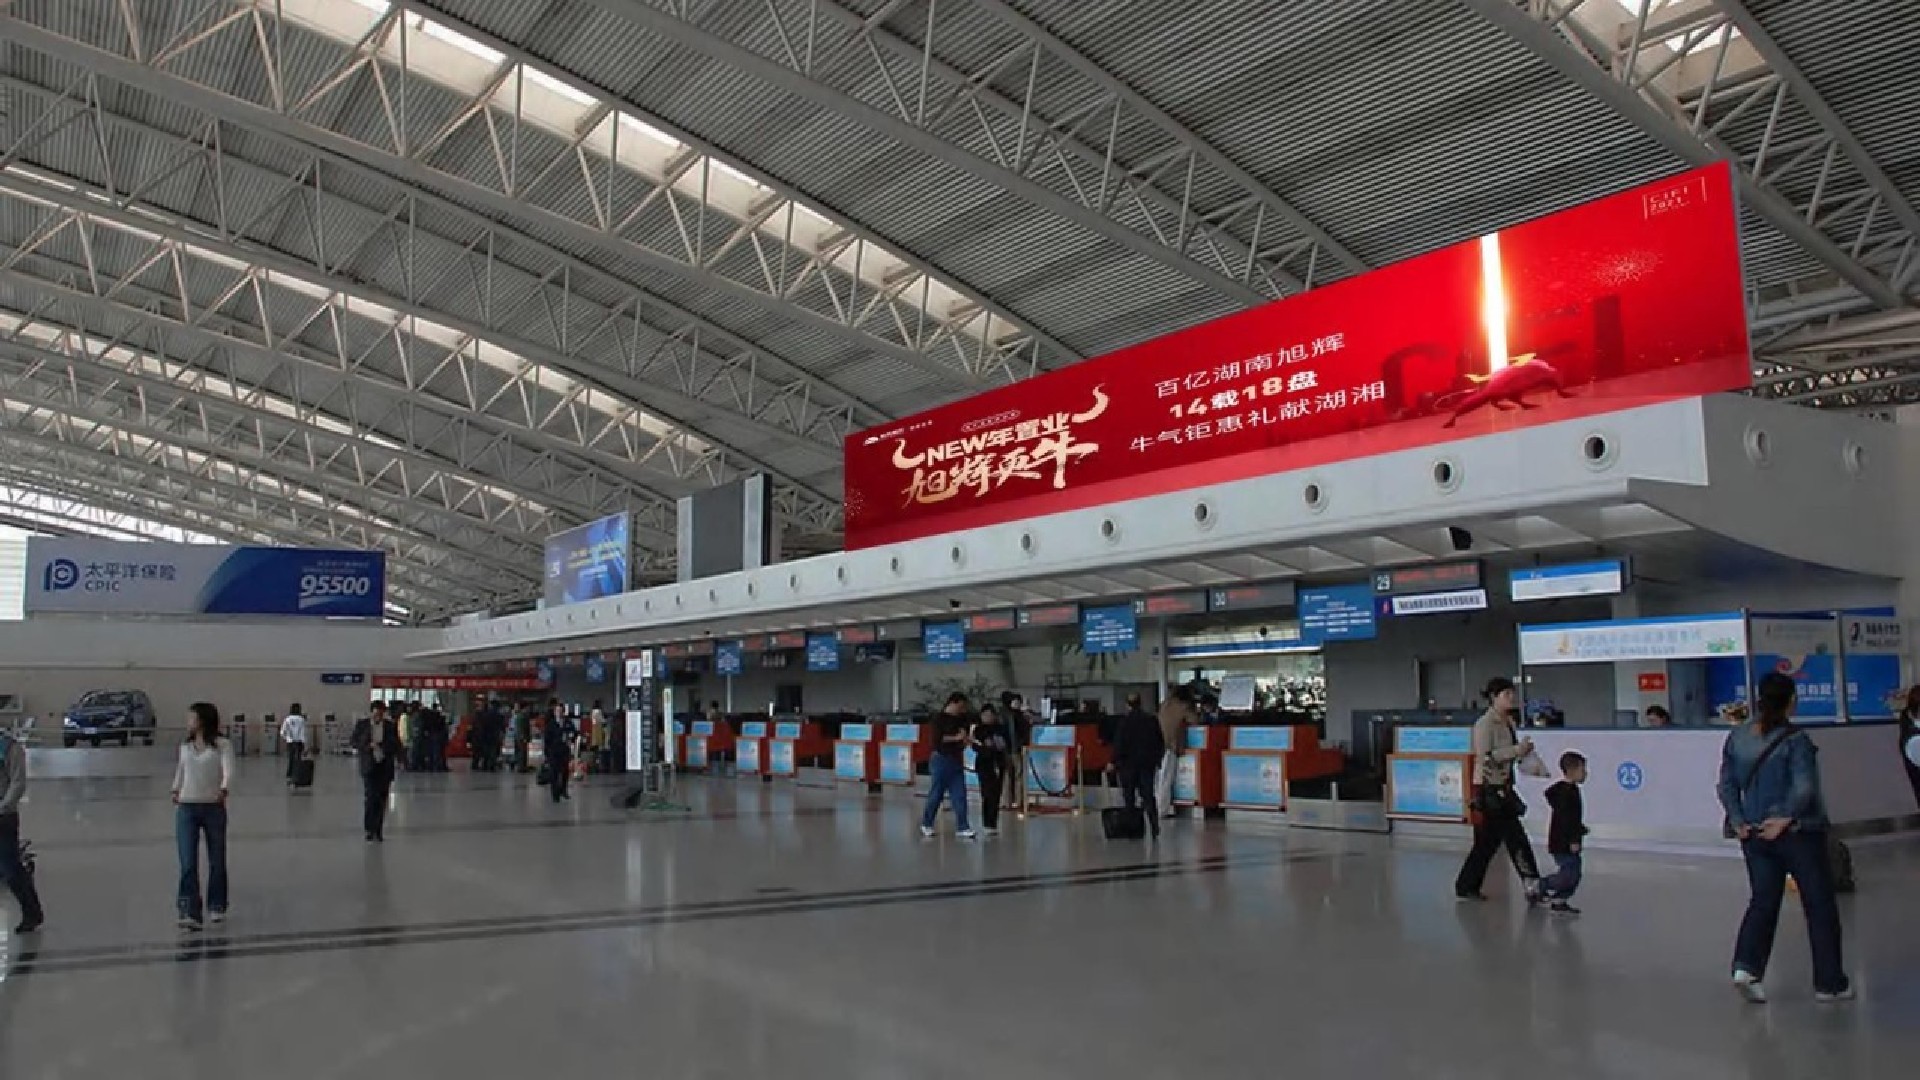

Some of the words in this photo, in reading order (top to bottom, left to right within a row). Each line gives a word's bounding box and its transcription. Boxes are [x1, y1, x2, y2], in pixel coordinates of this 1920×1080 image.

[1155, 332, 1345, 398] 百亿湖南旭辉
[1169, 370, 1319, 418] 14载18盘
[1129, 380, 1386, 452] 牛气钜惠礼献湖湘
[927, 412, 1070, 467] NEW年置业
[84, 561, 177, 581] 太平洋保险
[84, 580, 121, 593] CPIC
[300, 574, 371, 597] 95500
[1620, 766, 1640, 786] 25
